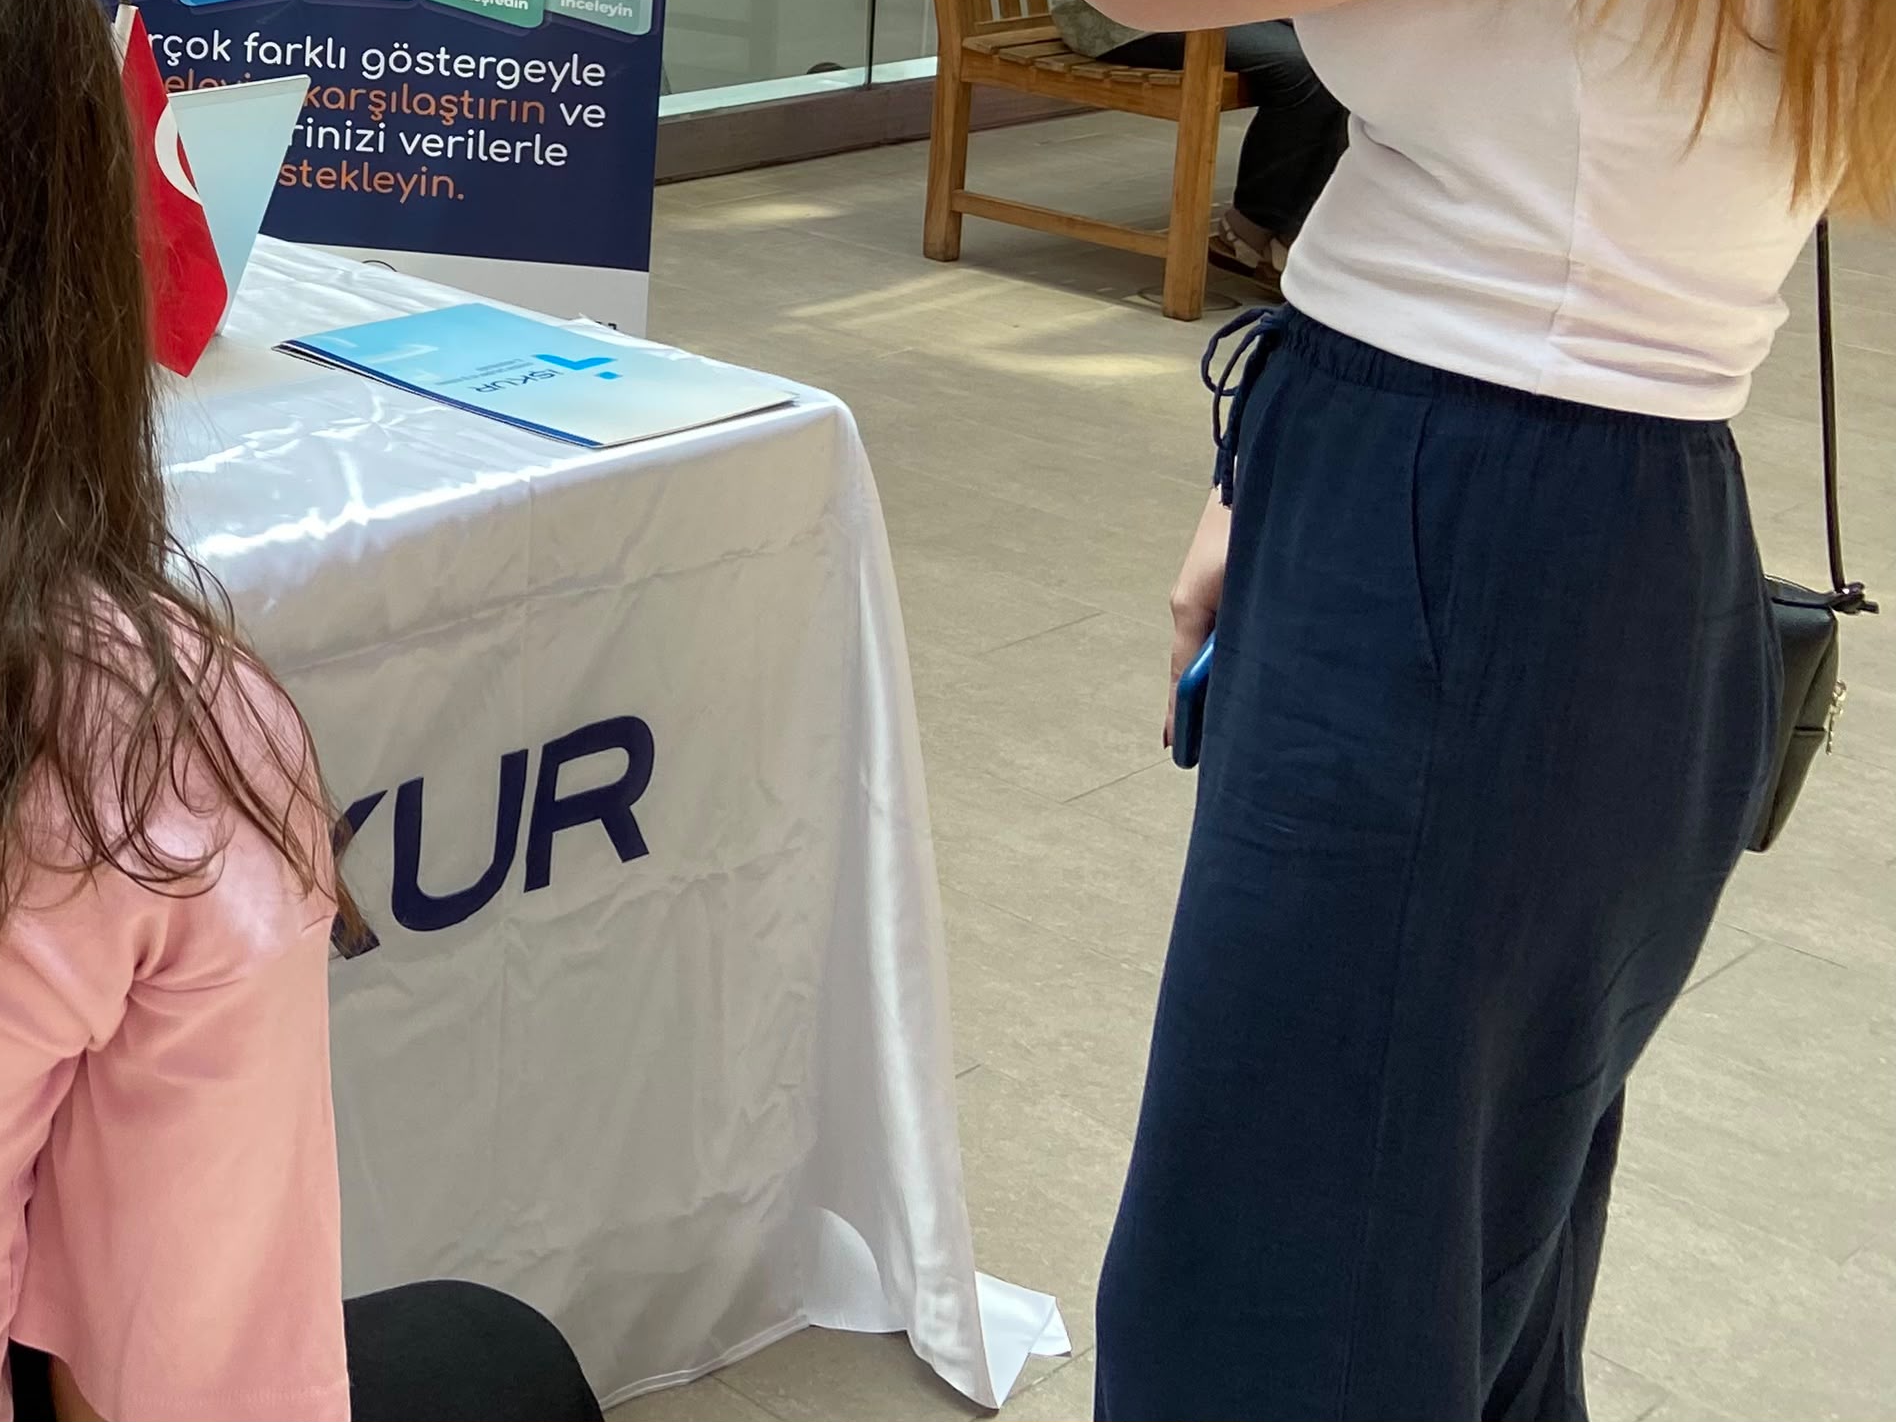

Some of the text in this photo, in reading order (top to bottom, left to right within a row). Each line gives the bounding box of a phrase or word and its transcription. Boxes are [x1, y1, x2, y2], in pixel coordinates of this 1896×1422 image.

[148, 29, 606, 93] rçok farklı göstergeyle
[560, 101, 605, 128] ve
[288, 117, 568, 166] rinizi verilerle
[278, 159, 465, 204] stekleyin.
[330, 715, 655, 960] KUR
